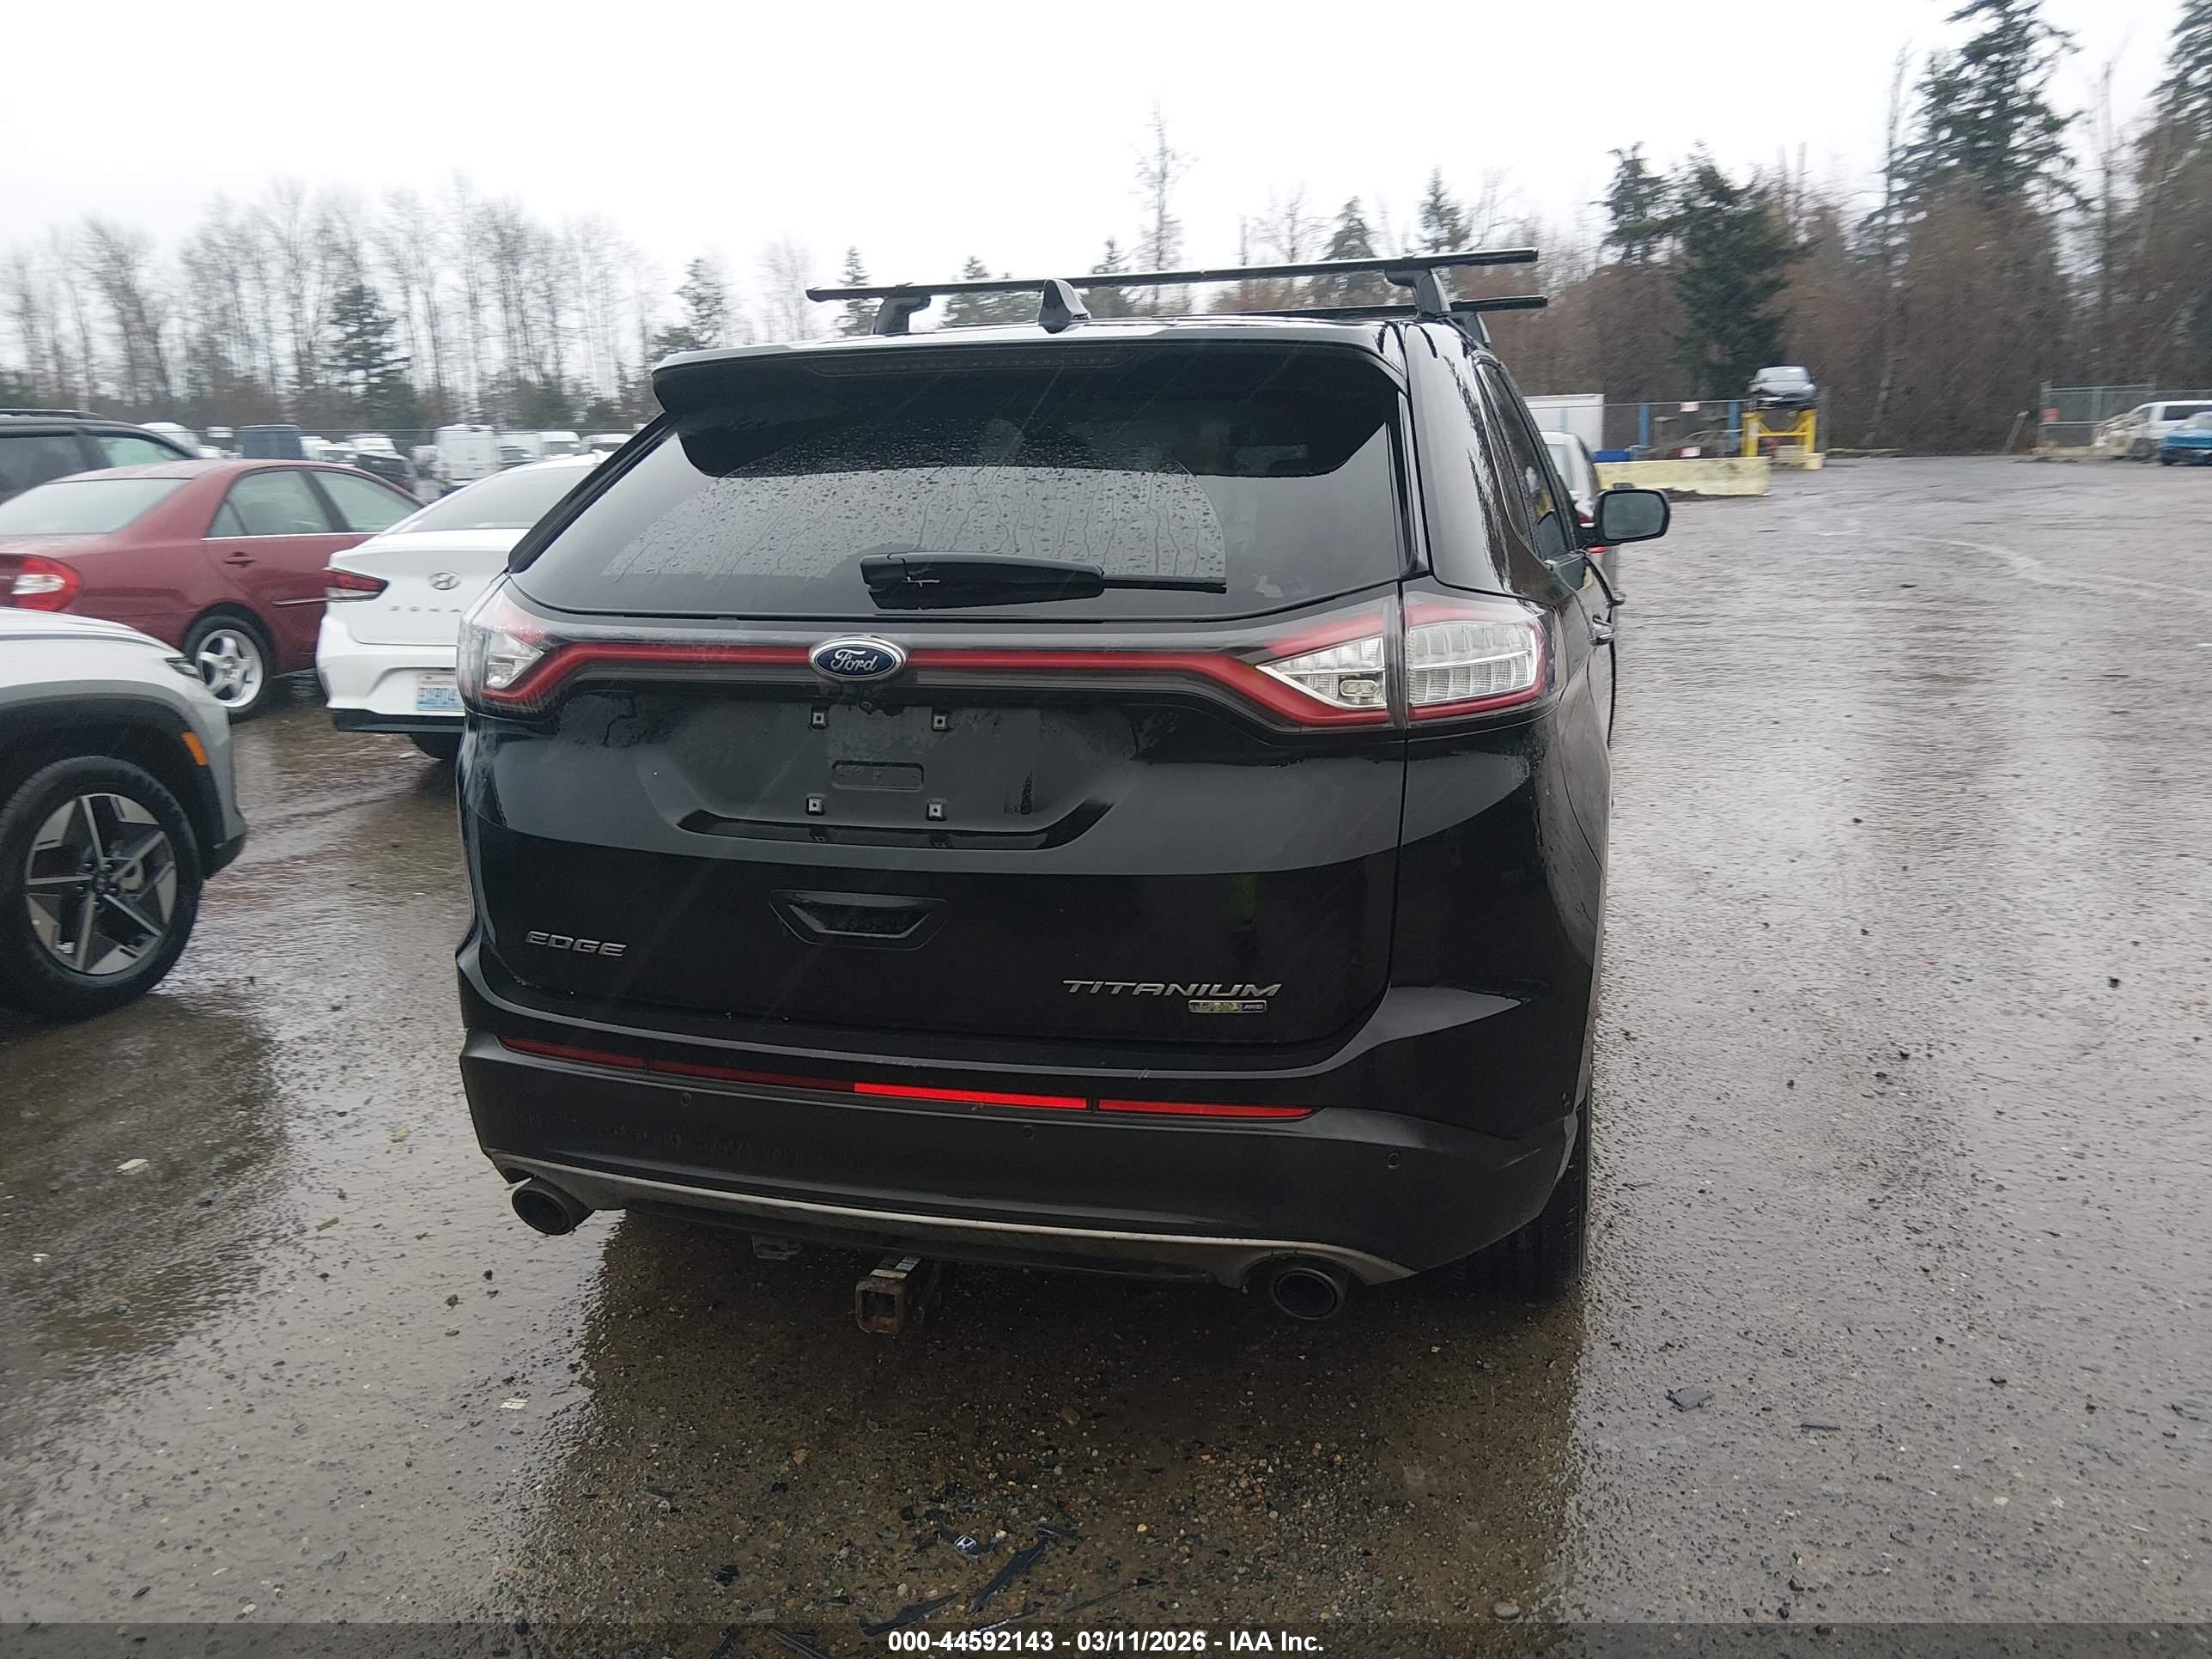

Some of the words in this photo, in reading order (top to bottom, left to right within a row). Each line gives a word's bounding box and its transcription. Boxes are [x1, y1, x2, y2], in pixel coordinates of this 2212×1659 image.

[830, 648, 879, 671] Ford
[526, 930, 627, 957] EDGE
[1062, 980, 1282, 997] TITANIUM
